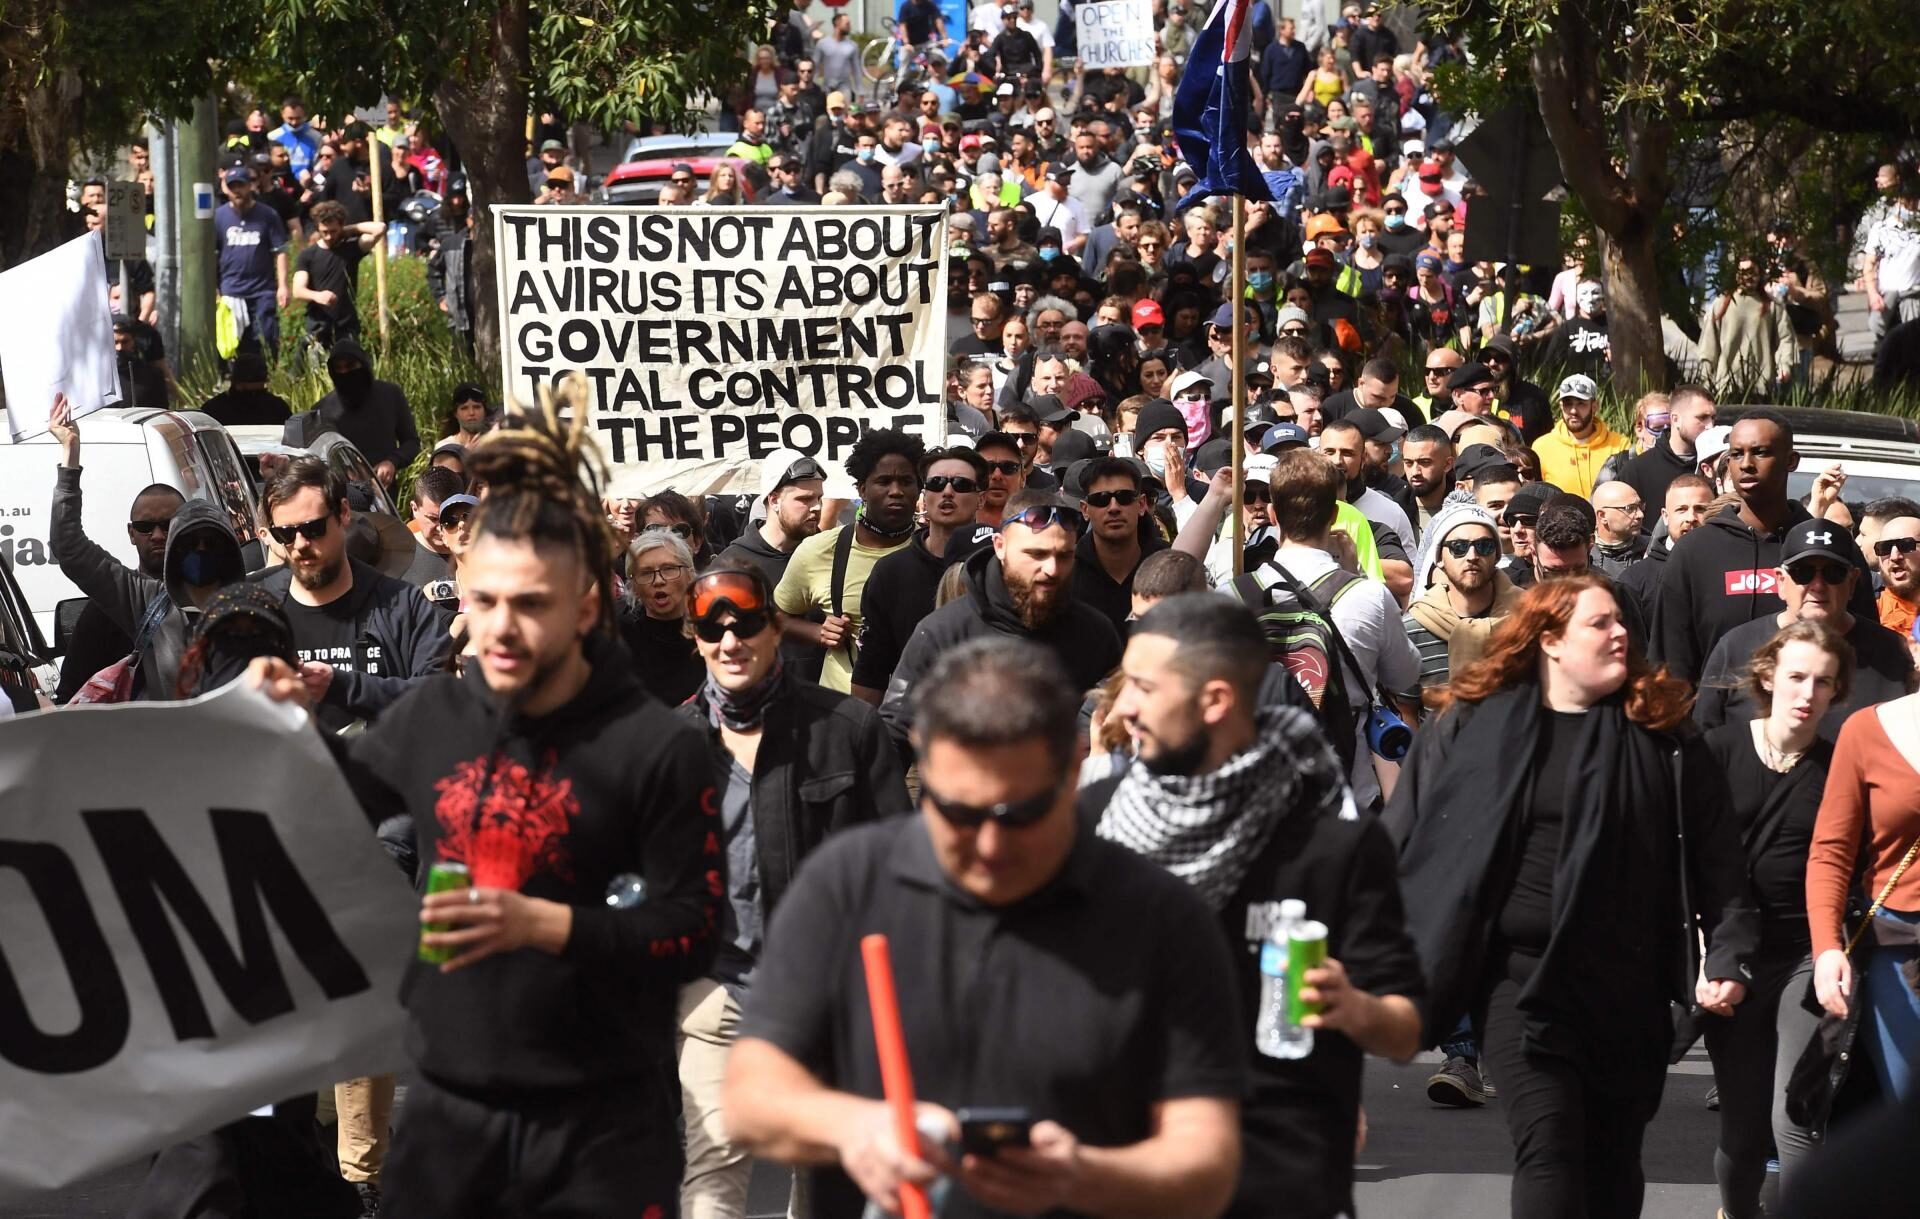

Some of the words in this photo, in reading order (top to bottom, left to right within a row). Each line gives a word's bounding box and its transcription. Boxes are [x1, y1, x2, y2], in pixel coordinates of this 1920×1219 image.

[1083, 3, 1140, 25] OPEN
[1102, 27, 1124, 37] THE
[1080, 37, 1154, 64] CHURCHES
[503, 215, 620, 263] THIS
[628, 215, 674, 261] IS
[678, 216, 773, 262] NOT
[778, 214, 940, 261] ABOUT
[510, 270, 547, 314] A
[543, 267, 682, 315] VIRUS
[693, 268, 767, 313] ITS
[775, 260, 938, 309] ABOUT
[518, 313, 913, 363] GOVERNMENT
[522, 366, 682, 412] TOTAL
[688, 360, 940, 409] CONTROL
[597, 416, 703, 463] THE
[297, 650, 311, 661] ER
[314, 648, 328, 660] TO
